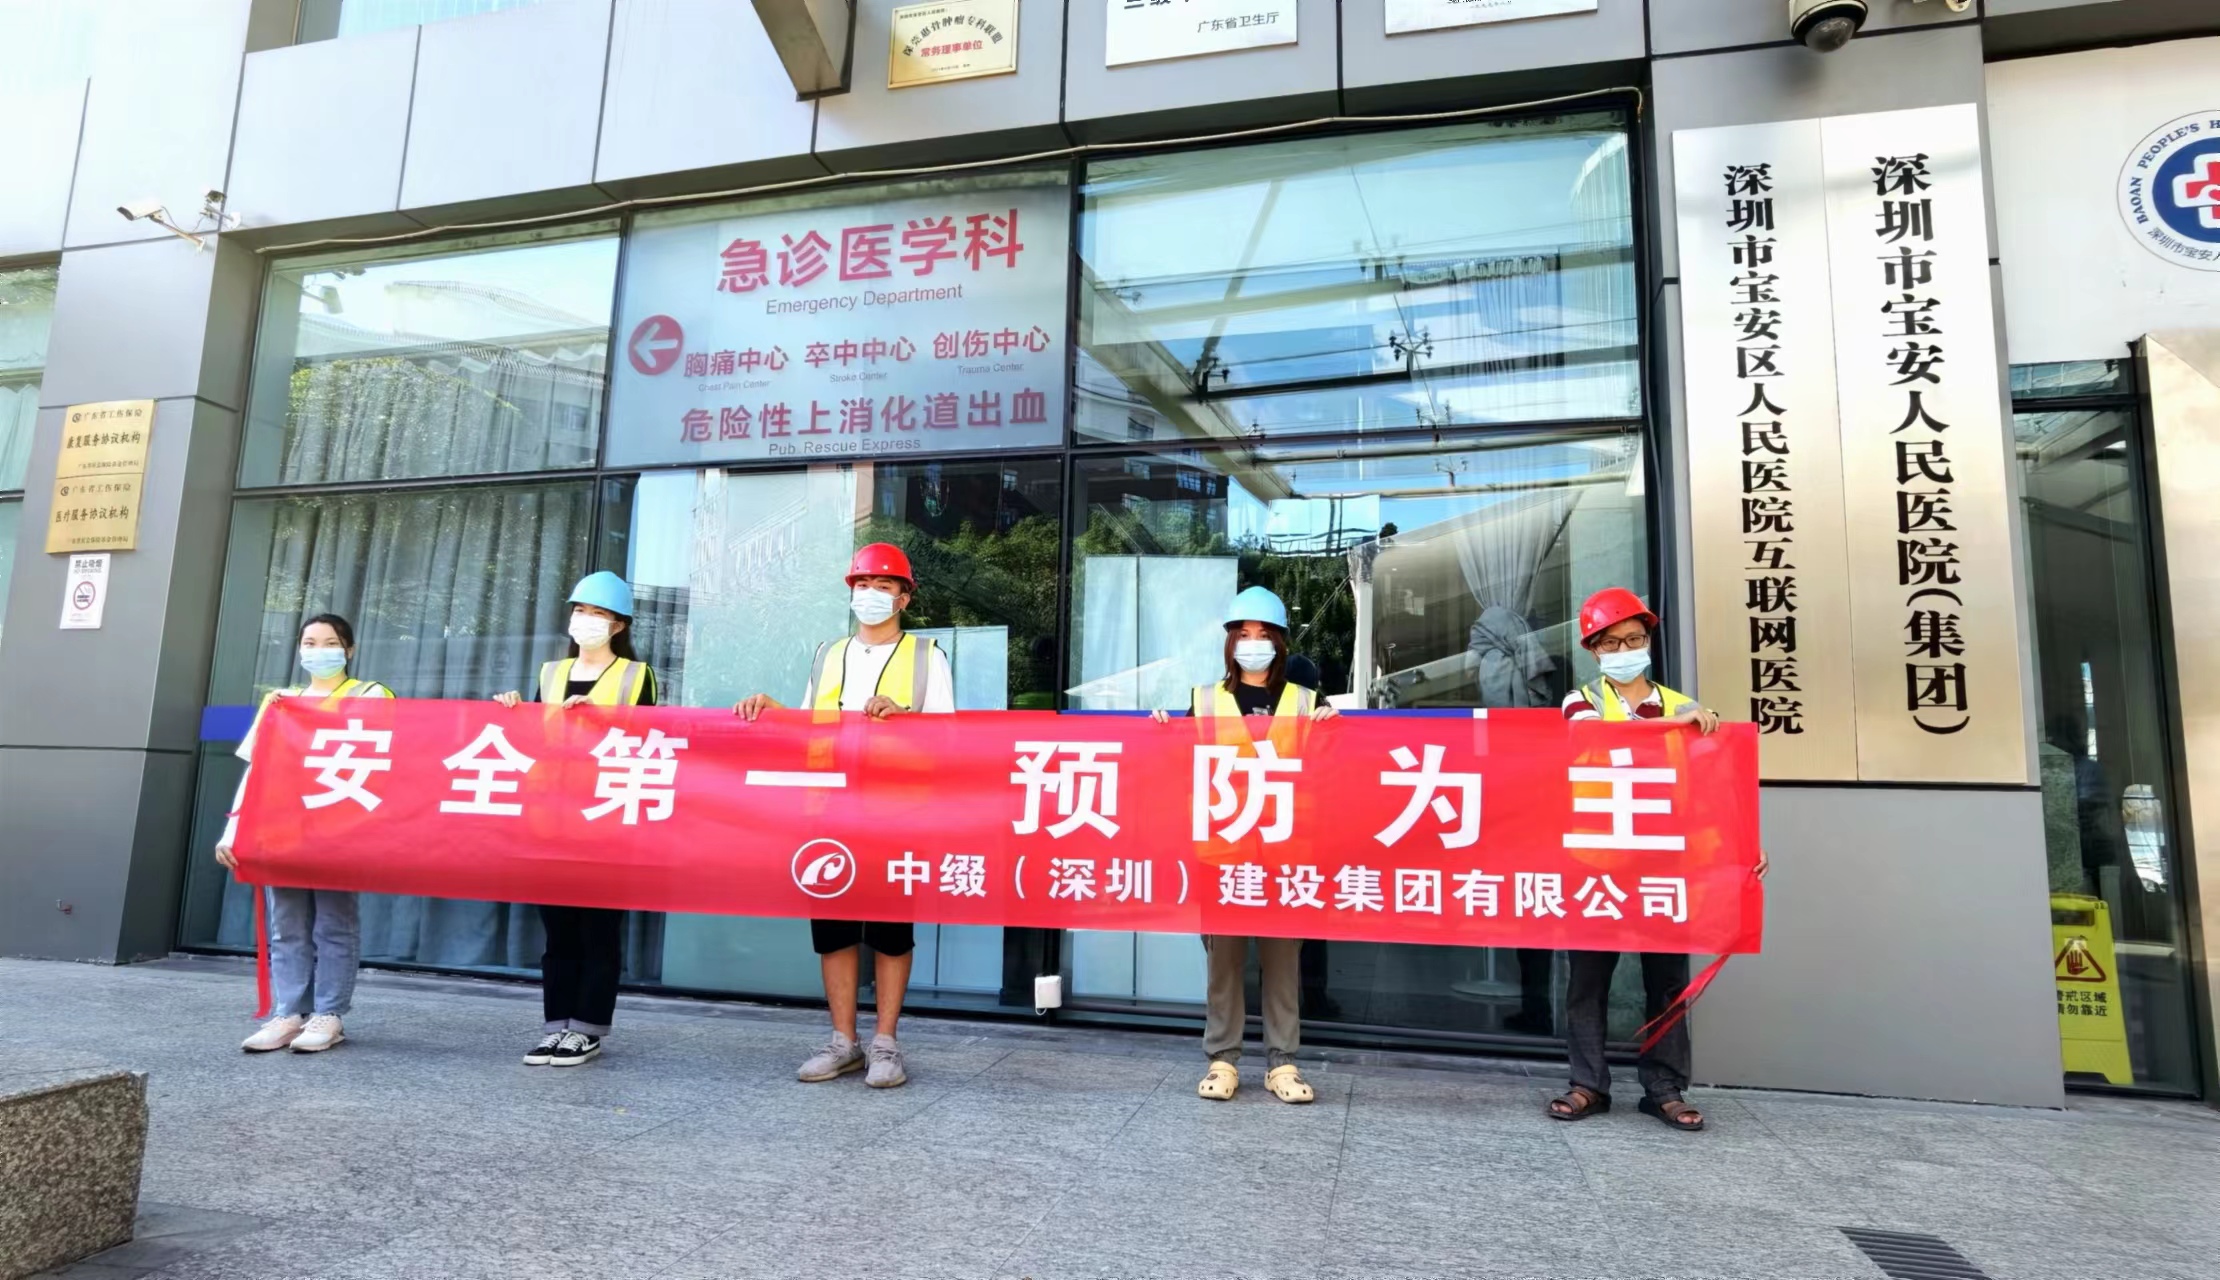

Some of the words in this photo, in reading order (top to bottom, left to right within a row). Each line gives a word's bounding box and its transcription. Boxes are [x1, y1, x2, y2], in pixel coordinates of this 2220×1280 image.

[1197, 11, 1279, 33] 广东省卫生厅
[921, 40, 983, 57] 常务理事单位
[2137, 122, 2200, 169] PEOPLE'S
[2129, 176, 2149, 224] BAOAN
[717, 208, 1024, 294] 急诊医学科
[766, 293, 858, 315] Emergency
[863, 284, 963, 308] Department
[683, 344, 789, 378] 胸痛中心
[804, 336, 917, 369] 卒中中心
[932, 325, 1050, 360] 创伤中心
[958, 365, 990, 374] Trauma
[829, 373, 857, 383] Stroke
[859, 371, 887, 381] Center
[680, 387, 1048, 443] 危险性上消化道出血
[804, 441, 857, 454] Rescue
[862, 438, 921, 451] Express
[1723, 163, 1804, 735] 深圳市宝安区人民医院互联网医院
[1871, 153, 1970, 735] 深圳市宝安人民医院(集团)
[56, 506, 129, 523] 医疗服务协议机构
[302, 718, 847, 825] 安全第一
[1010, 739, 1686, 852] 预防为主
